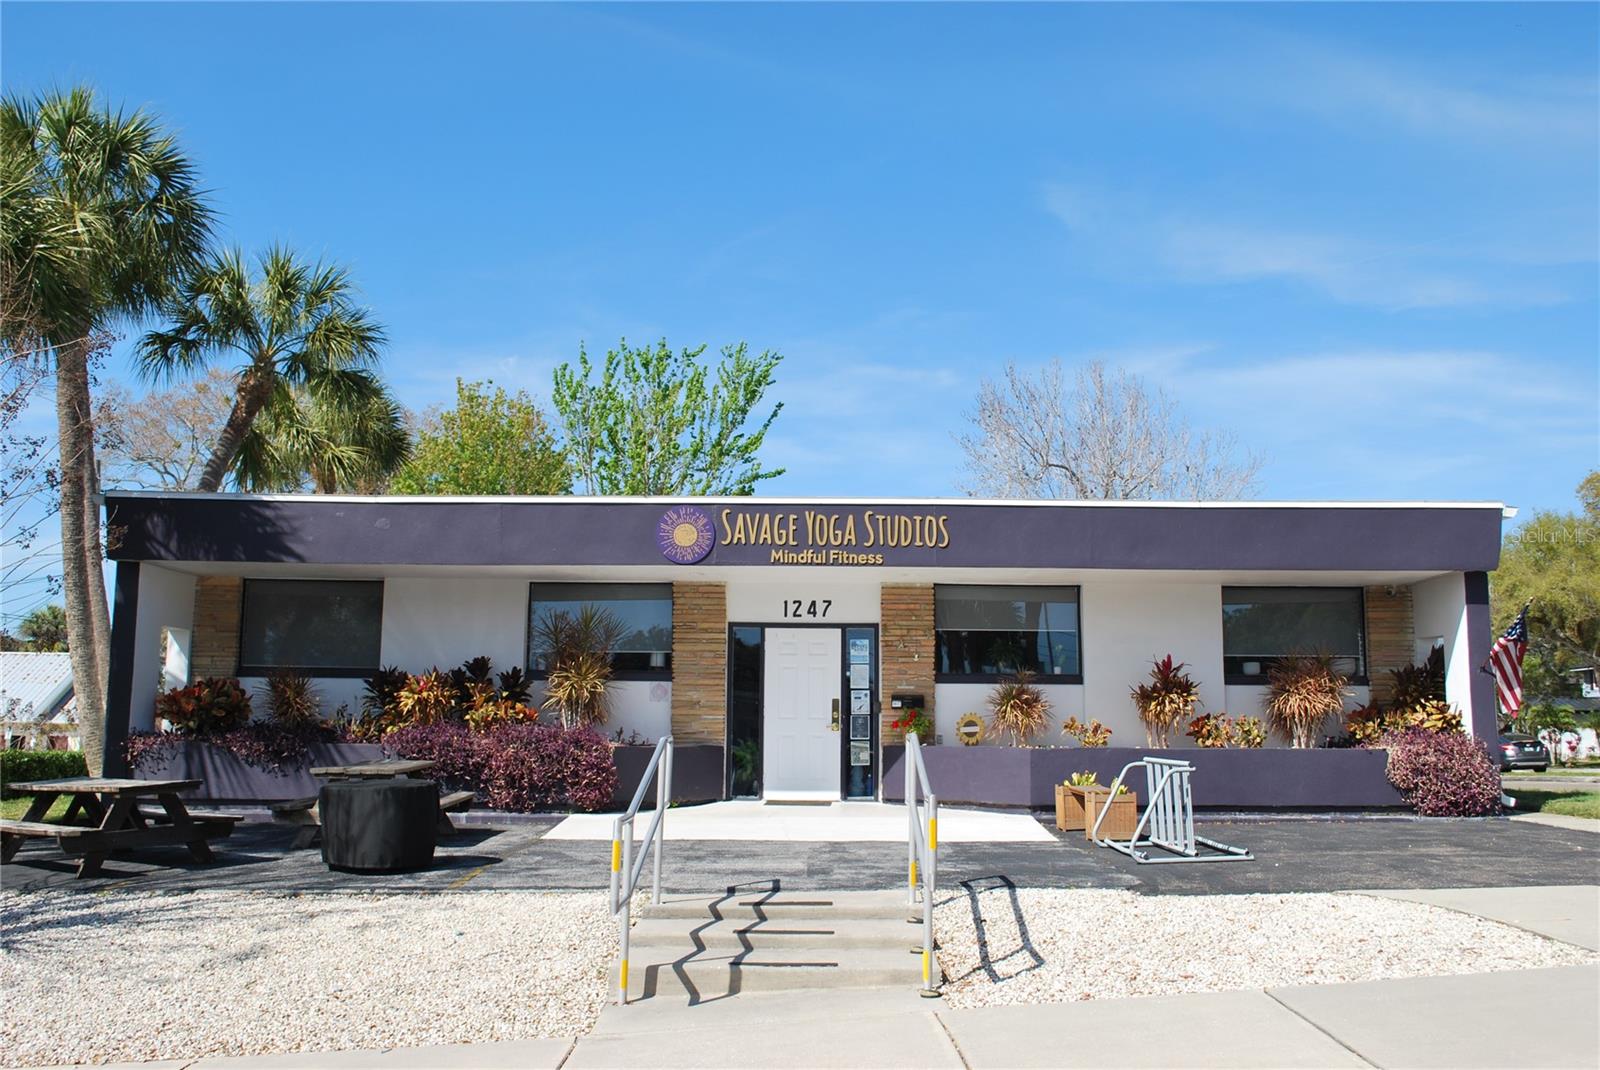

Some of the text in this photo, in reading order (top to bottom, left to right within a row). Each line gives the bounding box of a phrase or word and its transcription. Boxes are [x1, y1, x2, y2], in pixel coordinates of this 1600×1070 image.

[721, 508, 951, 549] SAVAGE YOGA STUDIOS
[770, 549, 884, 565] Mindful Fitness
[783, 600, 832, 618] 1247
